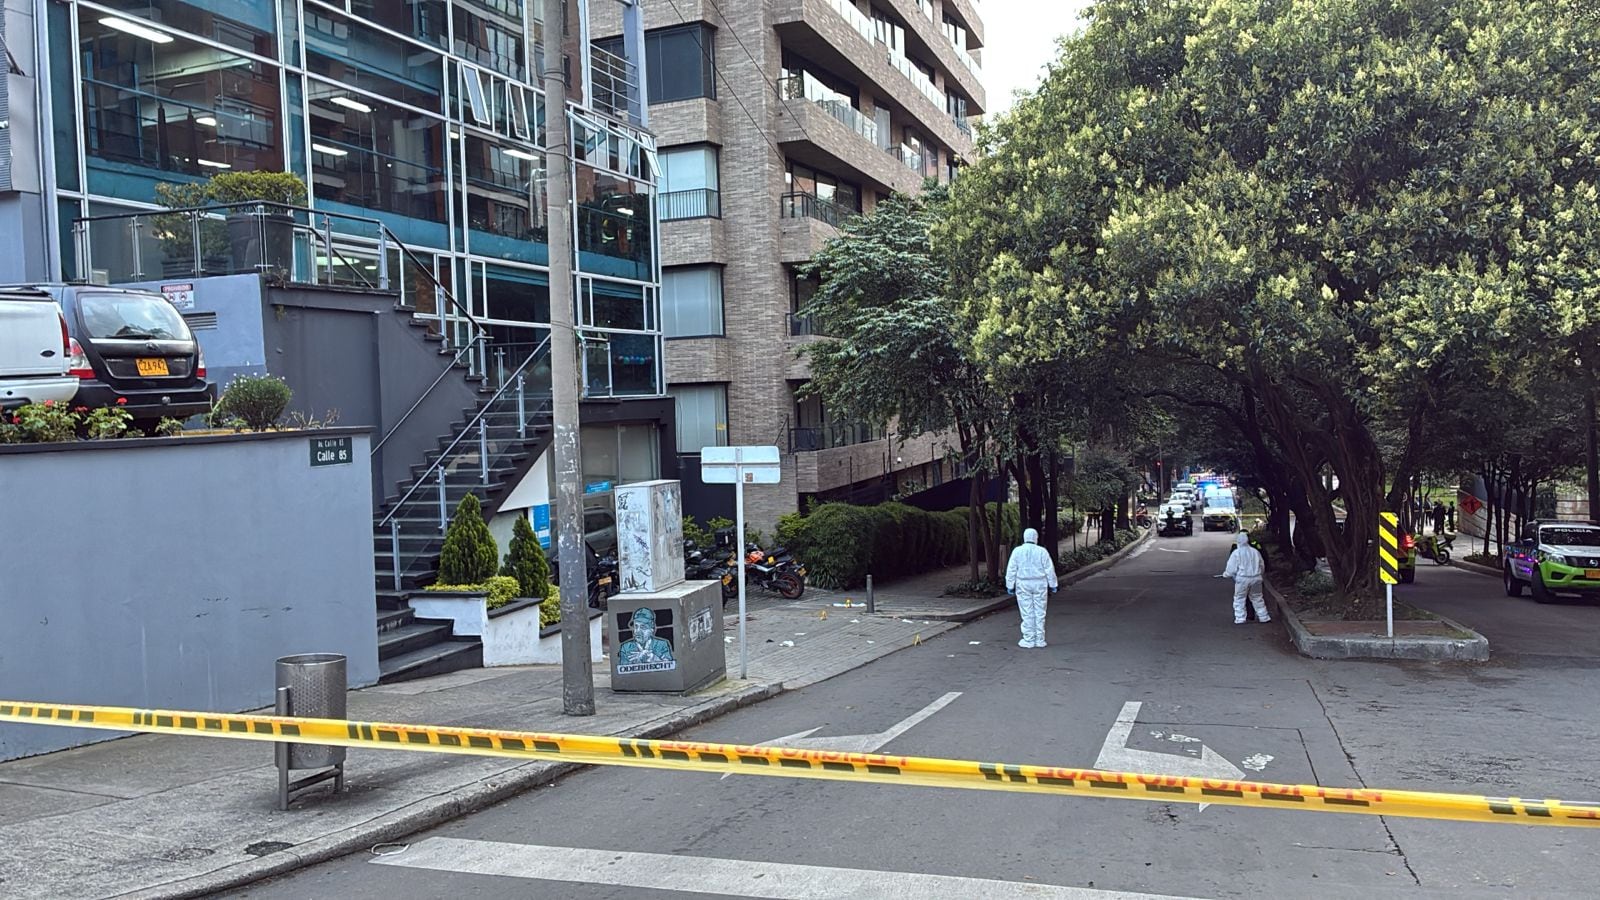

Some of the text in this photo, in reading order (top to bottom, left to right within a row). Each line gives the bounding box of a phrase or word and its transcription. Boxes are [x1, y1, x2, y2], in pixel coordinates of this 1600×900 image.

[152, 361, 167, 371] 942
[318, 450, 347, 462] Calle 85
[620, 662, 673, 672] ODEBRECHT
